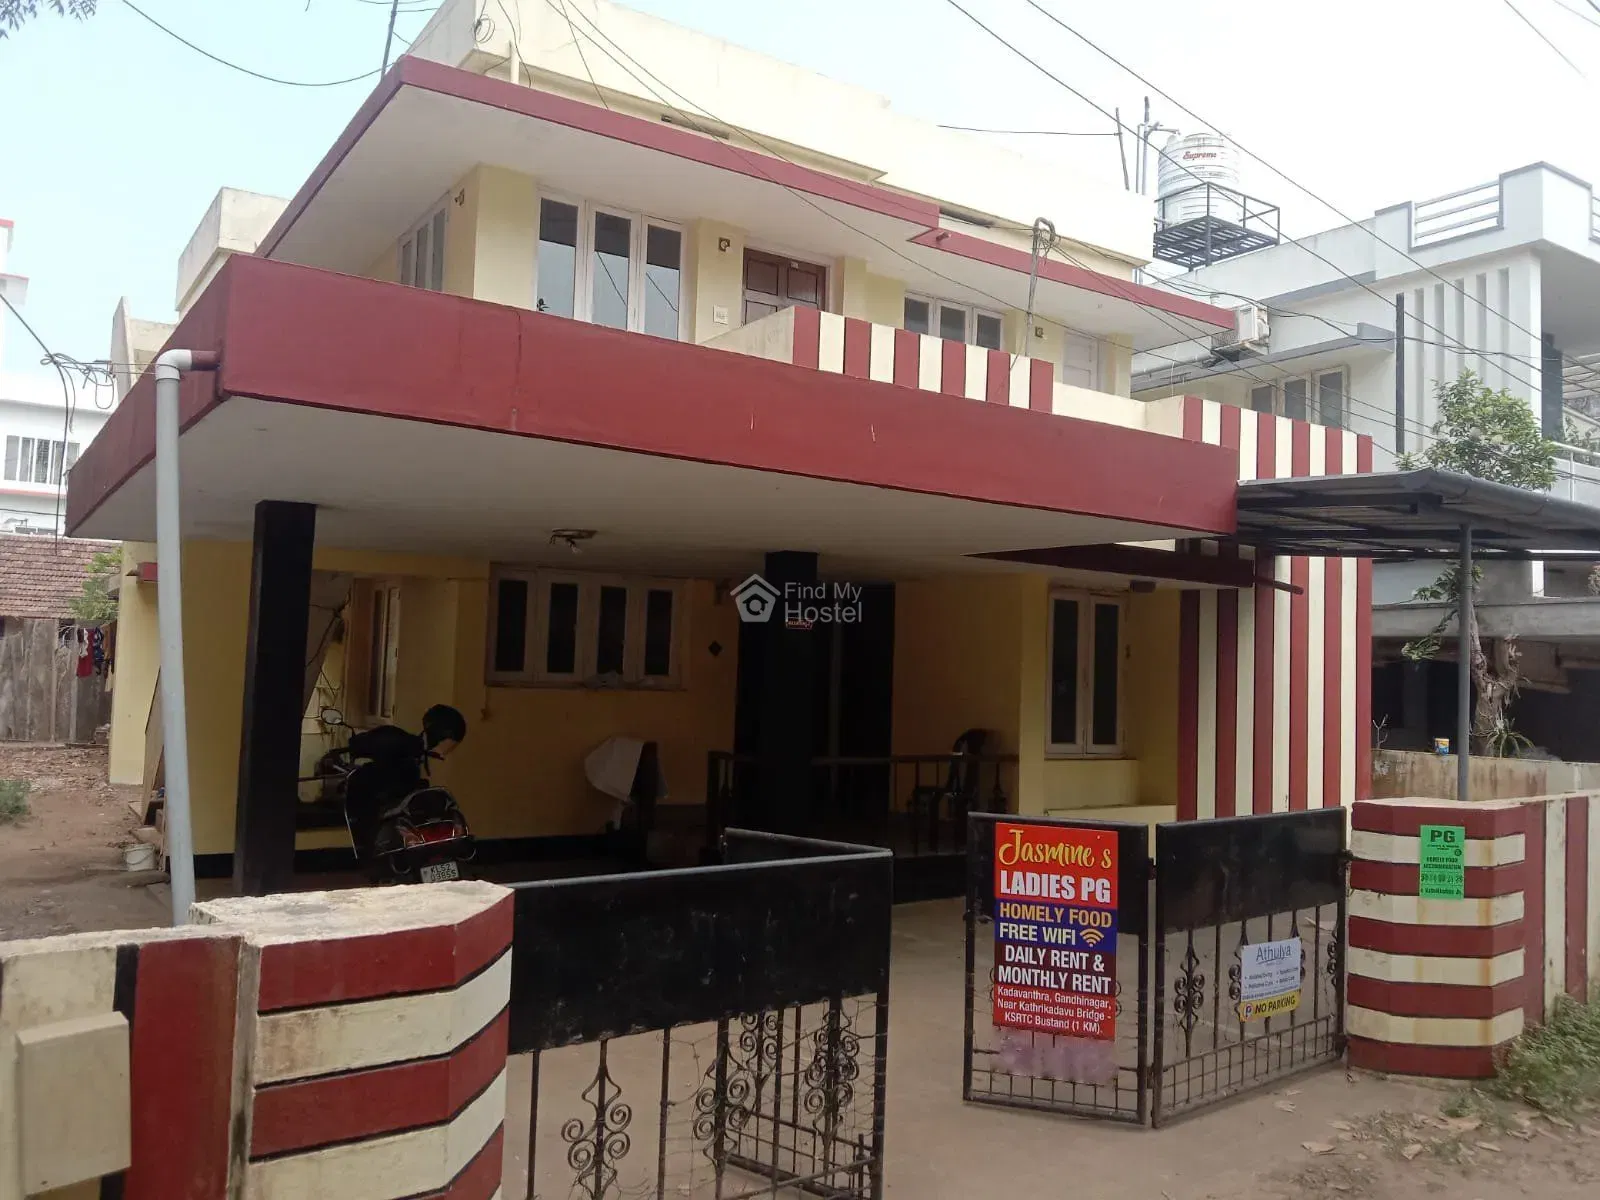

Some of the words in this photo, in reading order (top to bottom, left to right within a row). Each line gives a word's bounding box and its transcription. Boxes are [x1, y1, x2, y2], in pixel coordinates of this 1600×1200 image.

[1430, 829, 1456, 843] PG
[1000, 869, 1076, 900] LADIES
[1081, 876, 1111, 903] PG
[1000, 902, 1064, 923] HOMELY
[1069, 908, 1112, 928] FOOD
[999, 922, 1038, 942] FREE
[1042, 926, 1076, 946] WIFI
[1005, 944, 1046, 965] DAILY
[1051, 949, 1089, 970] RENT
[1093, 954, 1105, 972] &
[1256, 944, 1291, 961] Athulya
[998, 964, 1069, 990] MONTHLY
[1072, 973, 1112, 994] RENT
[997, 986, 1052, 1002] Kadavanthra,
[1054, 992, 1112, 1010] Gandhinagar,
[1255, 1002, 1267, 1014] NO
[1268, 995, 1296, 1011] PARKING
[997, 999, 1016, 1010] Near
[1019, 1001, 1074, 1017] Kathrikadavu
[1076, 1008, 1105, 1022] Bridge
[1004, 1012, 1033, 1025] KSRTC
[1035, 1015, 1070, 1029] Bustand
[1071, 1020, 1080, 1032] (1
